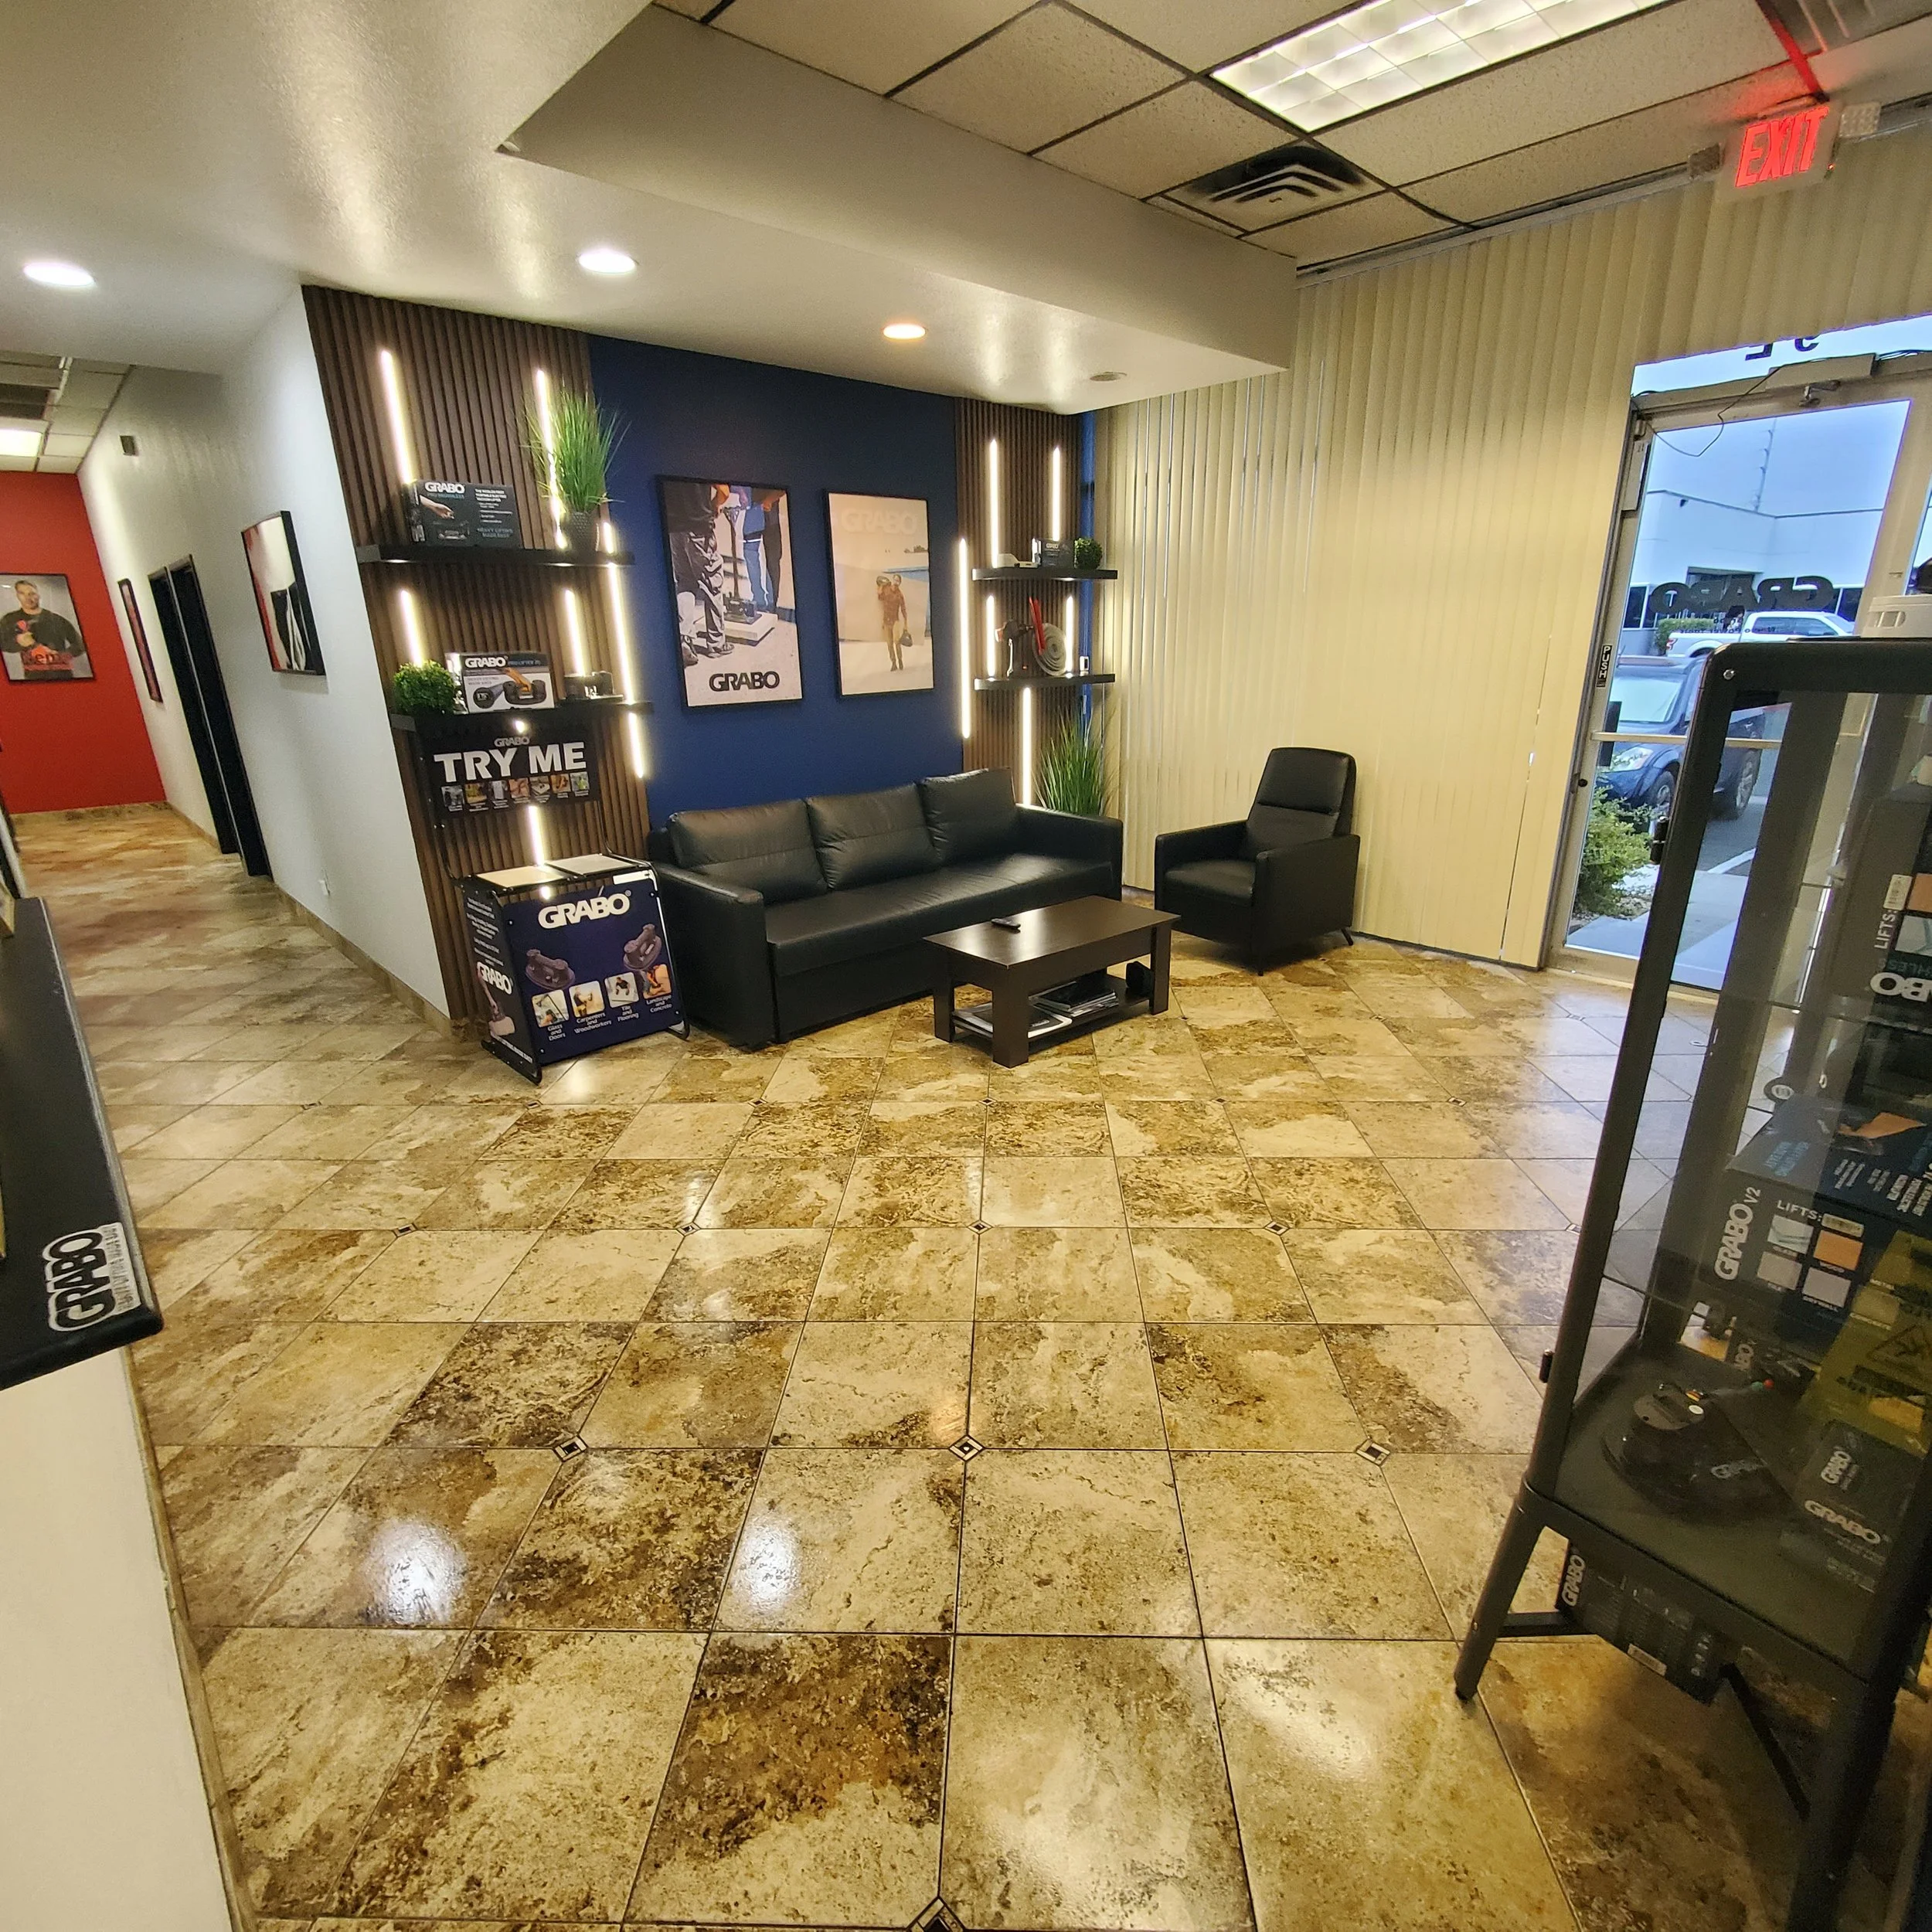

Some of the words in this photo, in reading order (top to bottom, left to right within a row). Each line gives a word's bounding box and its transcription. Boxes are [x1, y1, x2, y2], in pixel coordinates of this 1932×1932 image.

[1735, 107, 1829, 187] EXIT
[424, 481, 465, 494] GRABO
[841, 508, 919, 534] GRABO
[464, 657, 506, 668] GRABO
[1598, 645, 1611, 679] PUSH
[709, 672, 781, 692] GRABO
[494, 737, 531, 747] GRABO
[434, 748, 518, 782] TRY
[529, 742, 587, 774] ME
[539, 893, 631, 929] GRABO
[1873, 909, 1898, 950] LIFTS:
[476, 961, 512, 995] GRABO
[576, 1012, 606, 1024] Carpenters
[617, 1012, 639, 1022] Flooring
[650, 1003, 672, 1013] Concrete
[549, 1033, 566, 1042] Doors
[574, 1019, 612, 1034] Woodworkers
[1777, 1199, 1822, 1222] LIFTS:
[1714, 1202, 1753, 1281] GRABO
[1743, 1186, 1761, 1204] V2
[49, 1232, 116, 1329] GRABO
[1821, 1450, 1852, 1485] GRABO
[1804, 1499, 1882, 1545] GRABO
[1561, 1554, 1586, 1607] GRABO
